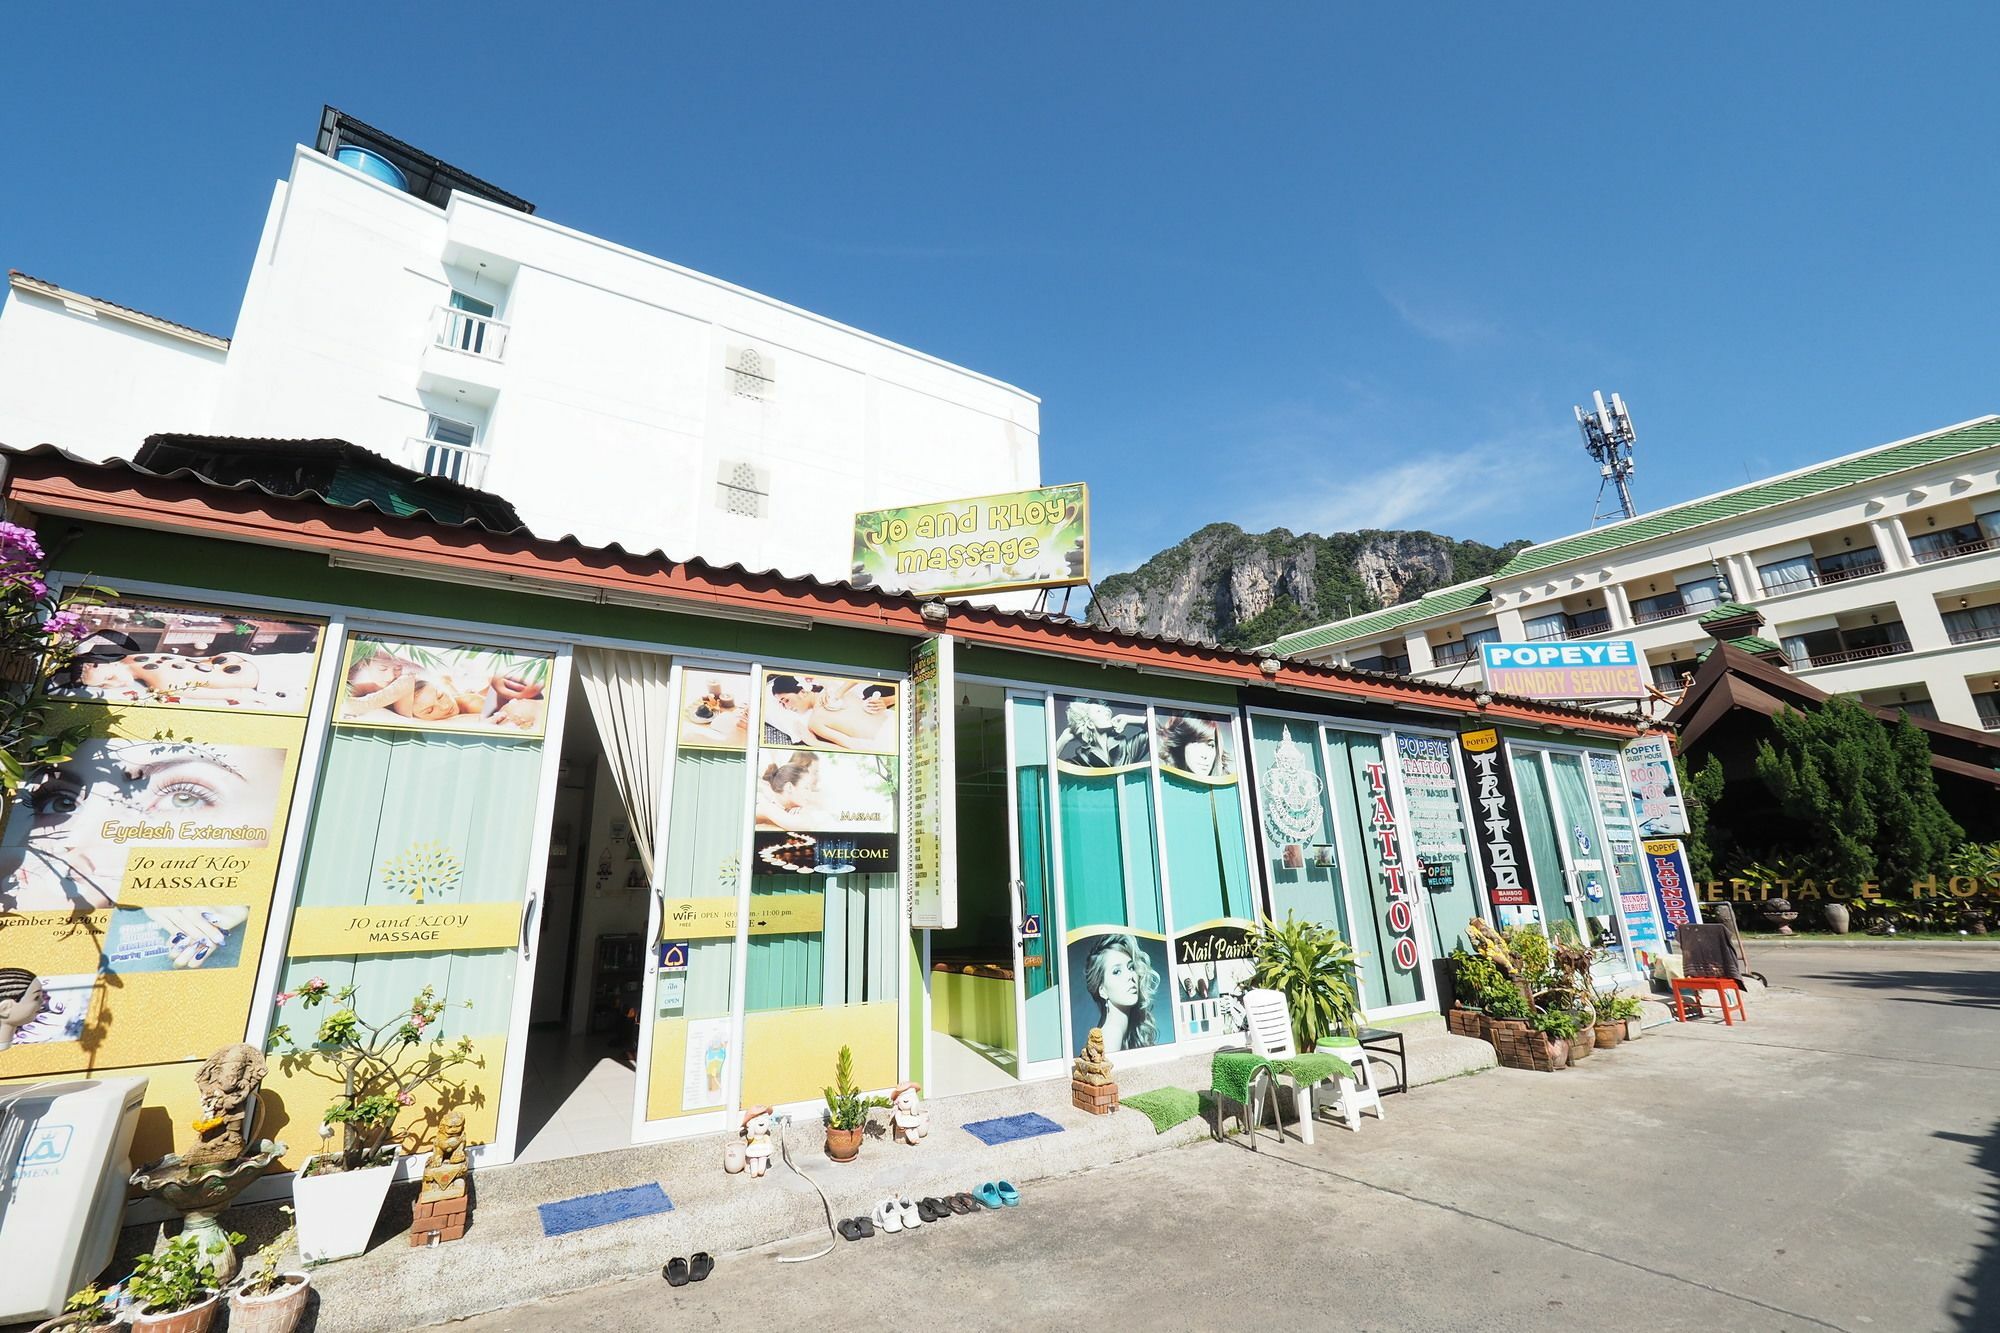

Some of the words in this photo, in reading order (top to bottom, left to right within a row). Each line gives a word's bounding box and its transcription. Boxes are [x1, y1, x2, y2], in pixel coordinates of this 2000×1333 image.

[915, 505, 978, 539] and
[896, 536, 1040, 574] massage
[1490, 646, 1631, 666] POPEYE
[1493, 671, 1569, 694] LAUNDRY
[1570, 669, 1640, 693] SERVICE
[1397, 736, 1450, 759] POPEYE
[1466, 736, 1495, 747] POPEYE
[1624, 744, 1661, 755] POPEYE
[1644, 752, 1662, 760] HOUSE
[1403, 758, 1451, 776] TATTOO
[1630, 765, 1668, 782] ROOM
[1640, 784, 1664, 800] FOR
[1643, 802, 1670, 817] RENT
[1471, 751, 1523, 889] TATTOO
[101, 819, 175, 844] Eyelash
[179, 822, 268, 841] Extension
[822, 848, 889, 859] WELCOME
[1647, 843, 1677, 852] POPEYE
[128, 856, 155, 872] Jo
[160, 855, 204, 869] and
[204, 855, 251, 873] Kloy
[1366, 761, 1418, 969] TATTOO
[1428, 866, 1450, 877] OPEN
[131, 876, 239, 889] MASSAGE
[1428, 877, 1452, 886] WELCOME
[1912, 873, 2000, 899] HO
[1655, 858, 1690, 930] LAUNDRY
[345, 918, 371, 931] JO
[376, 915, 415, 928] and
[416, 914, 469, 928] KLOY
[673, 911, 697, 920] WiFi
[725, 920, 755, 928] SLE
[368, 931, 440, 942] MASSAGE
[1182, 935, 1215, 962] Nail
